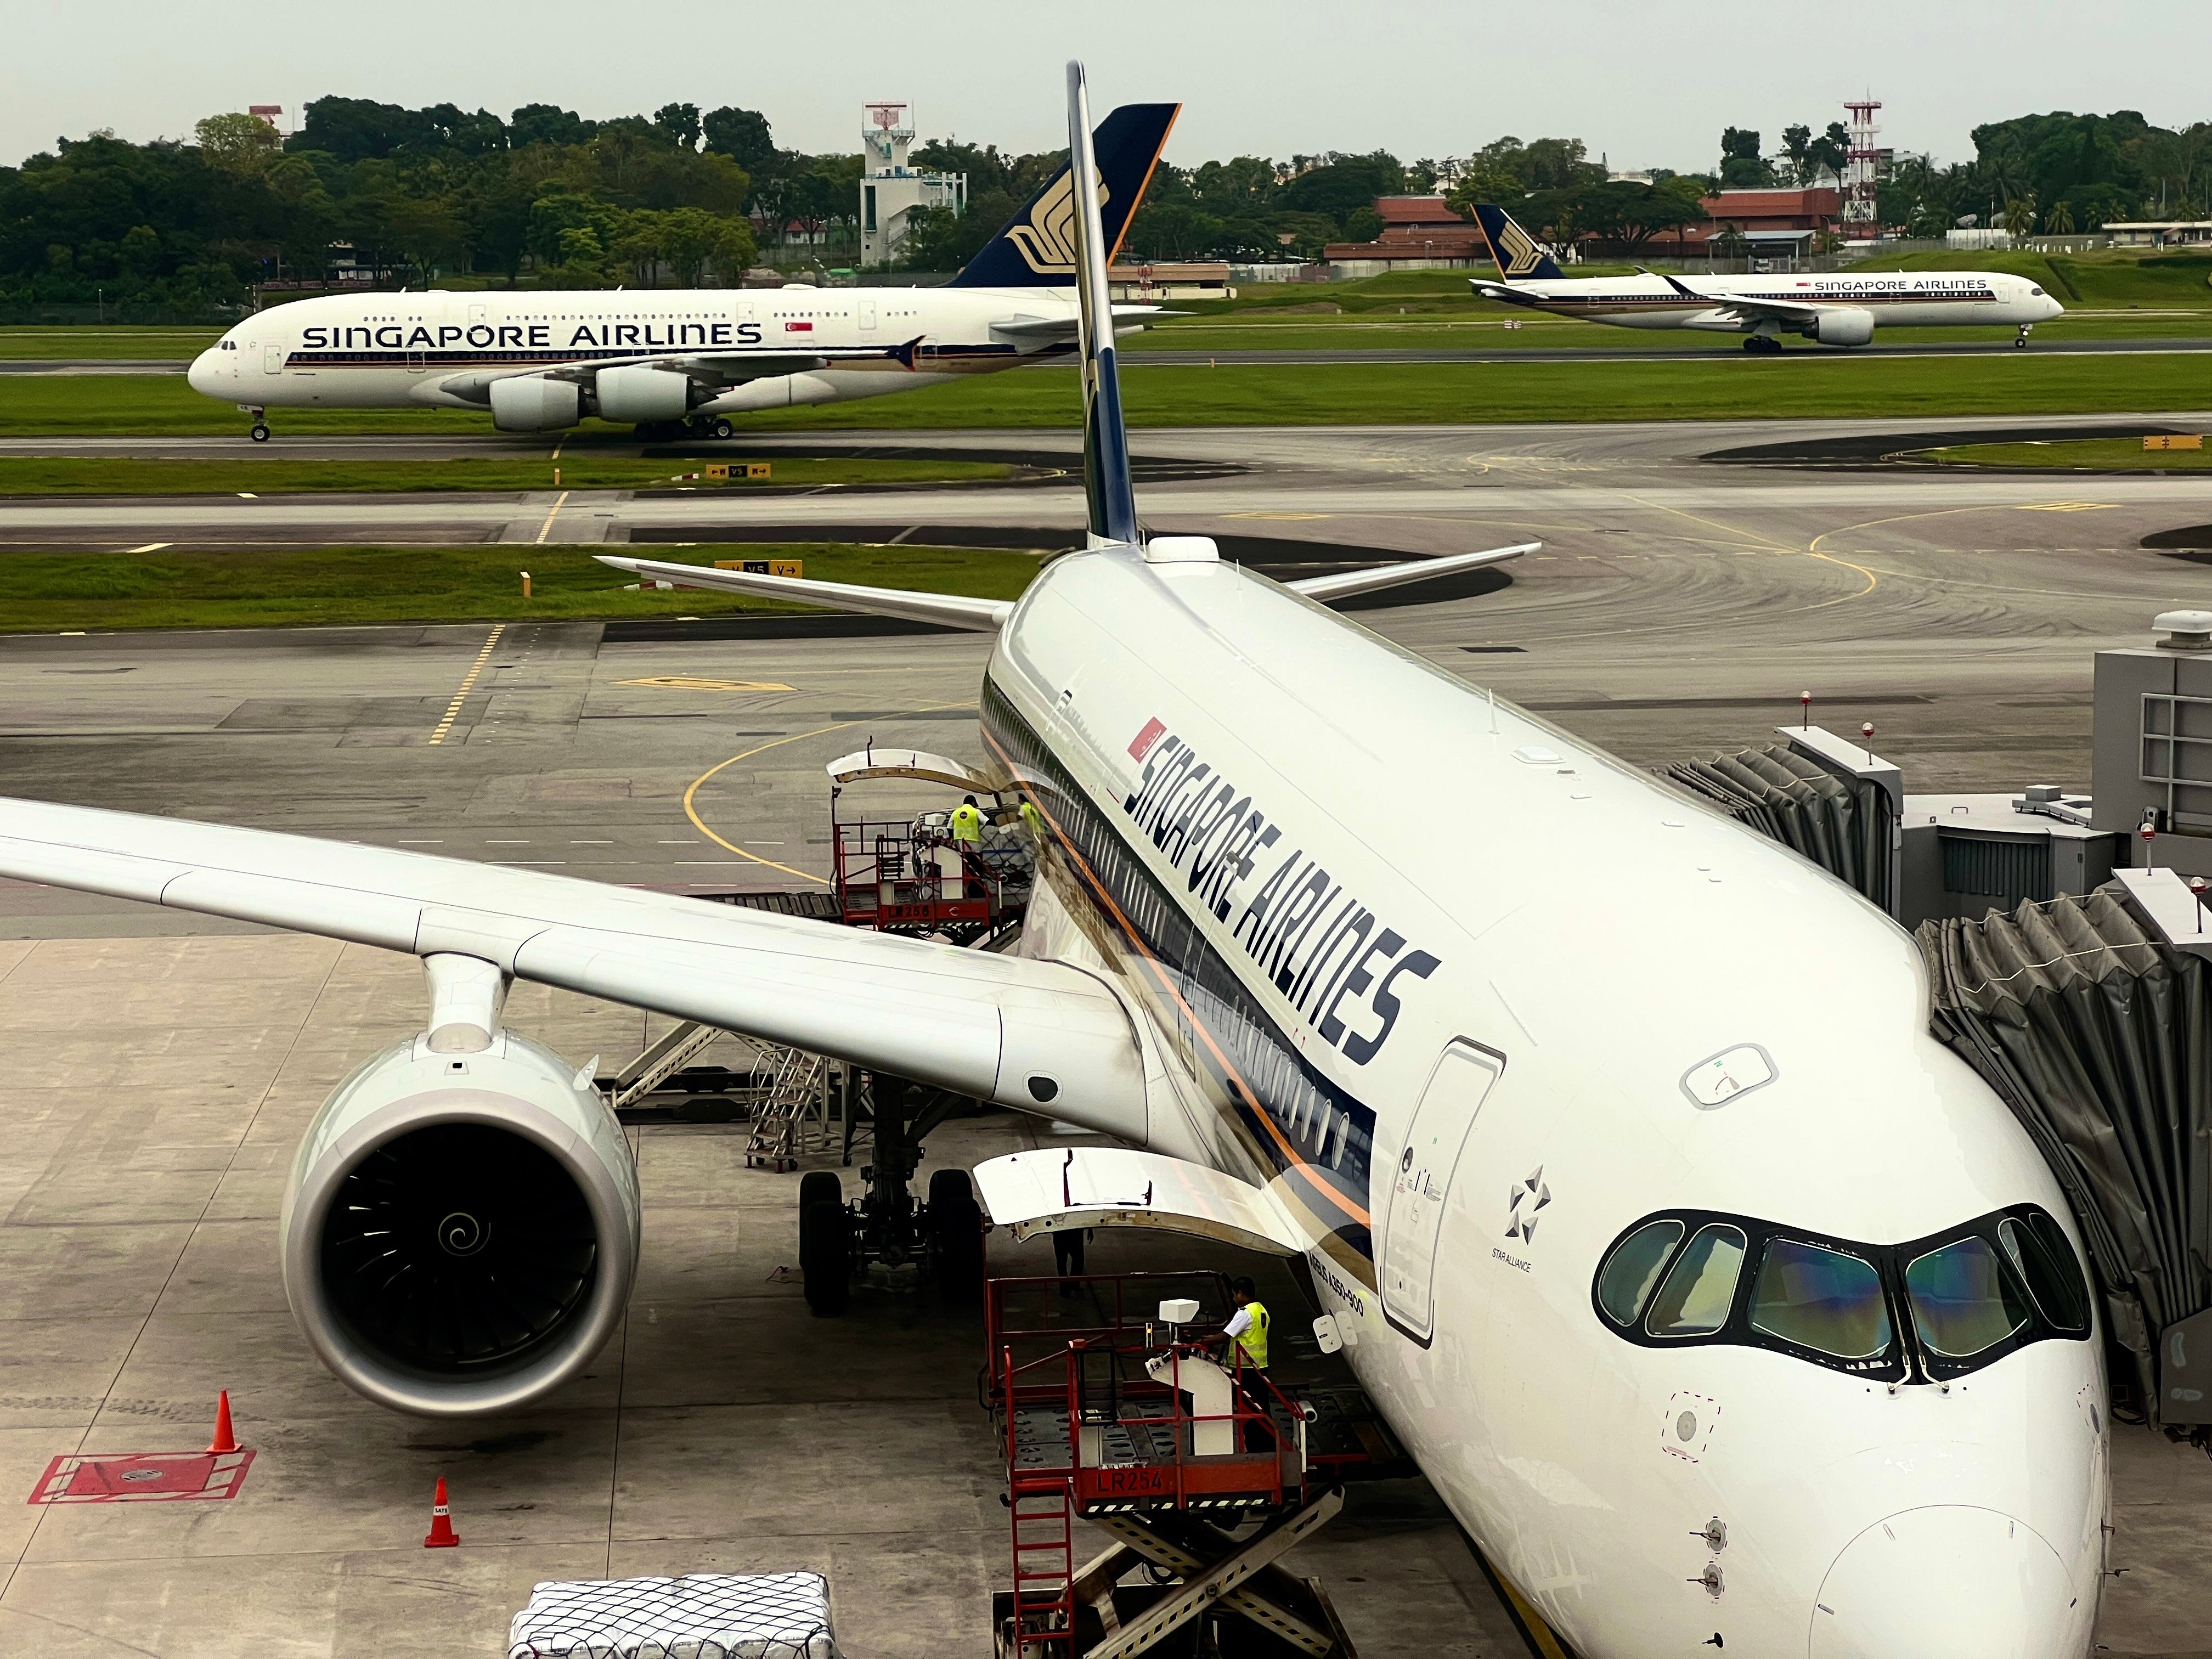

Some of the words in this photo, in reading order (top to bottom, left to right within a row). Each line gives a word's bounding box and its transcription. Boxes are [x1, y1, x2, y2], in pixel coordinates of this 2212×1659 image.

[1815, 281, 1906, 290] SINGAPORE
[1914, 280, 1987, 289] AIRLINES
[302, 325, 550, 348] SINGAPORE
[569, 323, 762, 347] AIRLINES
[777, 565, 784, 575] V
[1124, 735, 1283, 924] SINGAPORE
[1233, 849, 1442, 1066] AIRLINES
[1492, 1248, 1506, 1262] STAR
[1505, 1255, 1532, 1273] ALLIANCE
[1328, 1271, 1364, 1317] A350-900
[1097, 1470, 1163, 1493] LR254
